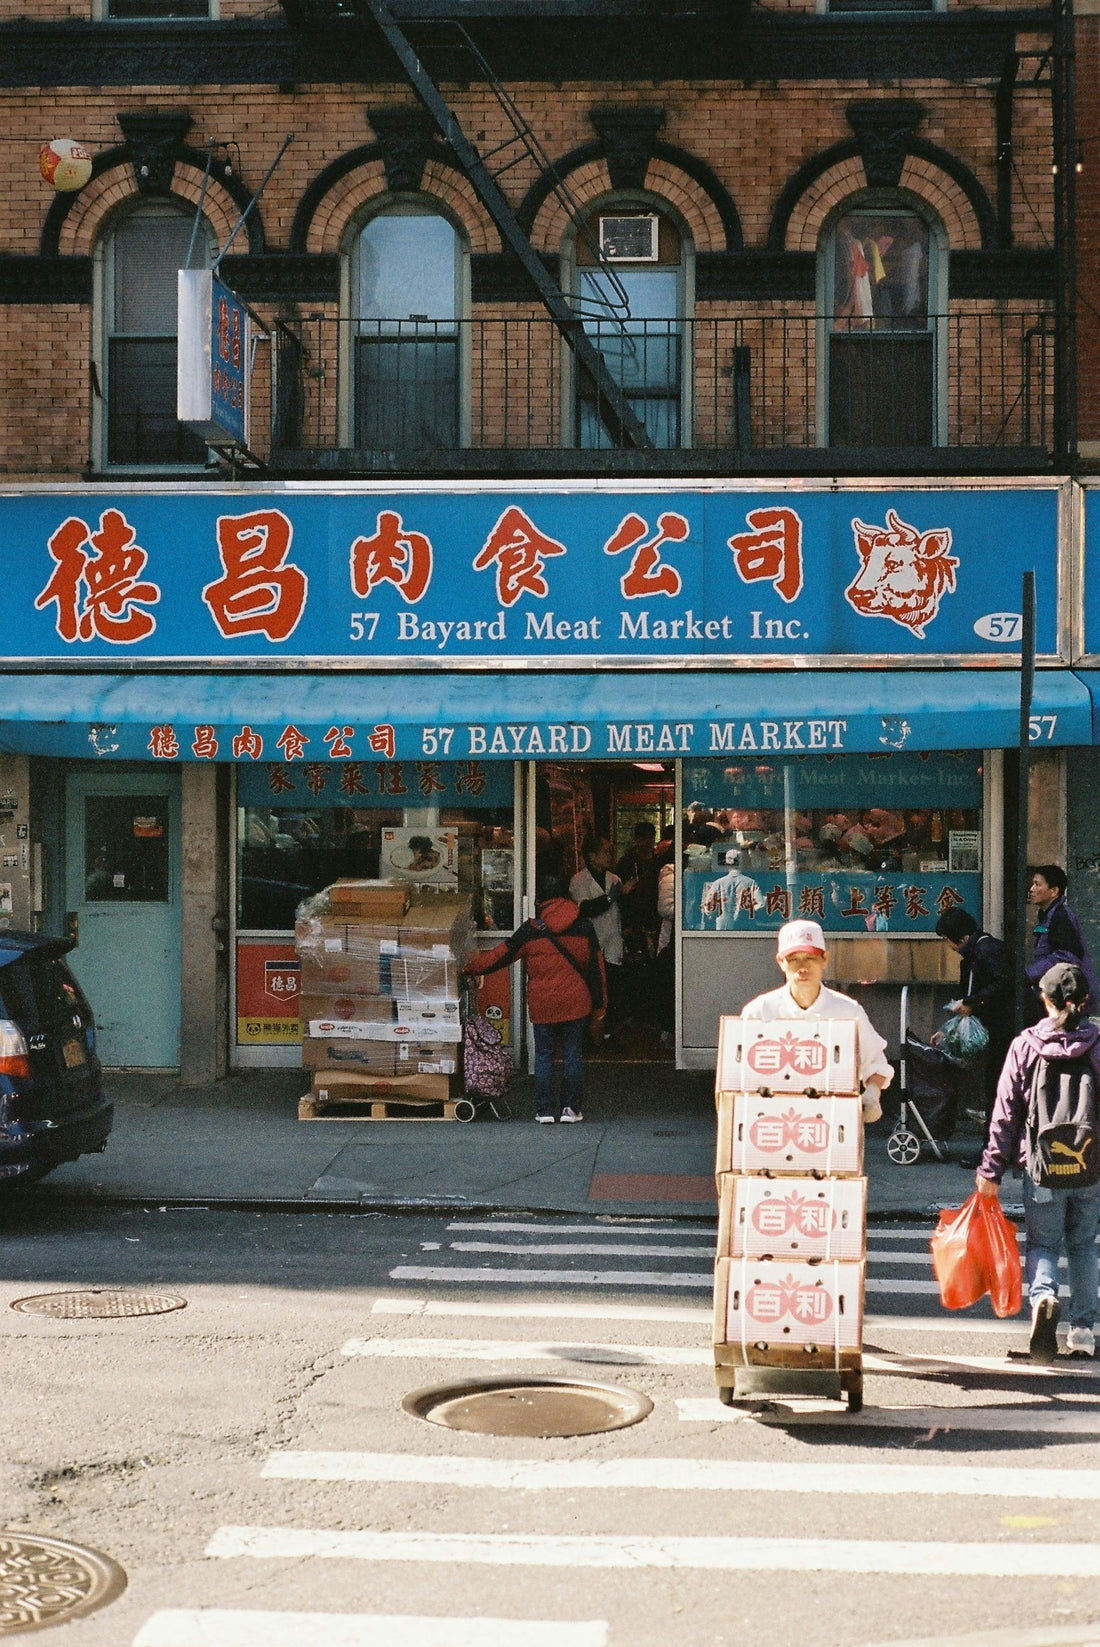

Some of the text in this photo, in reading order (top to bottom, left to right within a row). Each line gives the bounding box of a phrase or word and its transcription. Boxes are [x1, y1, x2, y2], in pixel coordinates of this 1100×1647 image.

[35, 505, 804, 644] 德昌肉食公司
[350, 609, 810, 649] 57 Bayard Meat Market Inc.
[988, 617, 1020, 639] 57
[147, 723, 397, 761] 德昌肉食公司
[421, 719, 848, 756] 57 BAYARD MEAT MARKET
[1027, 715, 1057, 741] 57
[755, 1044, 823, 1071] 百利
[756, 1124, 829, 1148] 百利
[1048, 1163, 1080, 1175] PUMA
[758, 1204, 827, 1232] 百利
[752, 1289, 827, 1320] 百利
